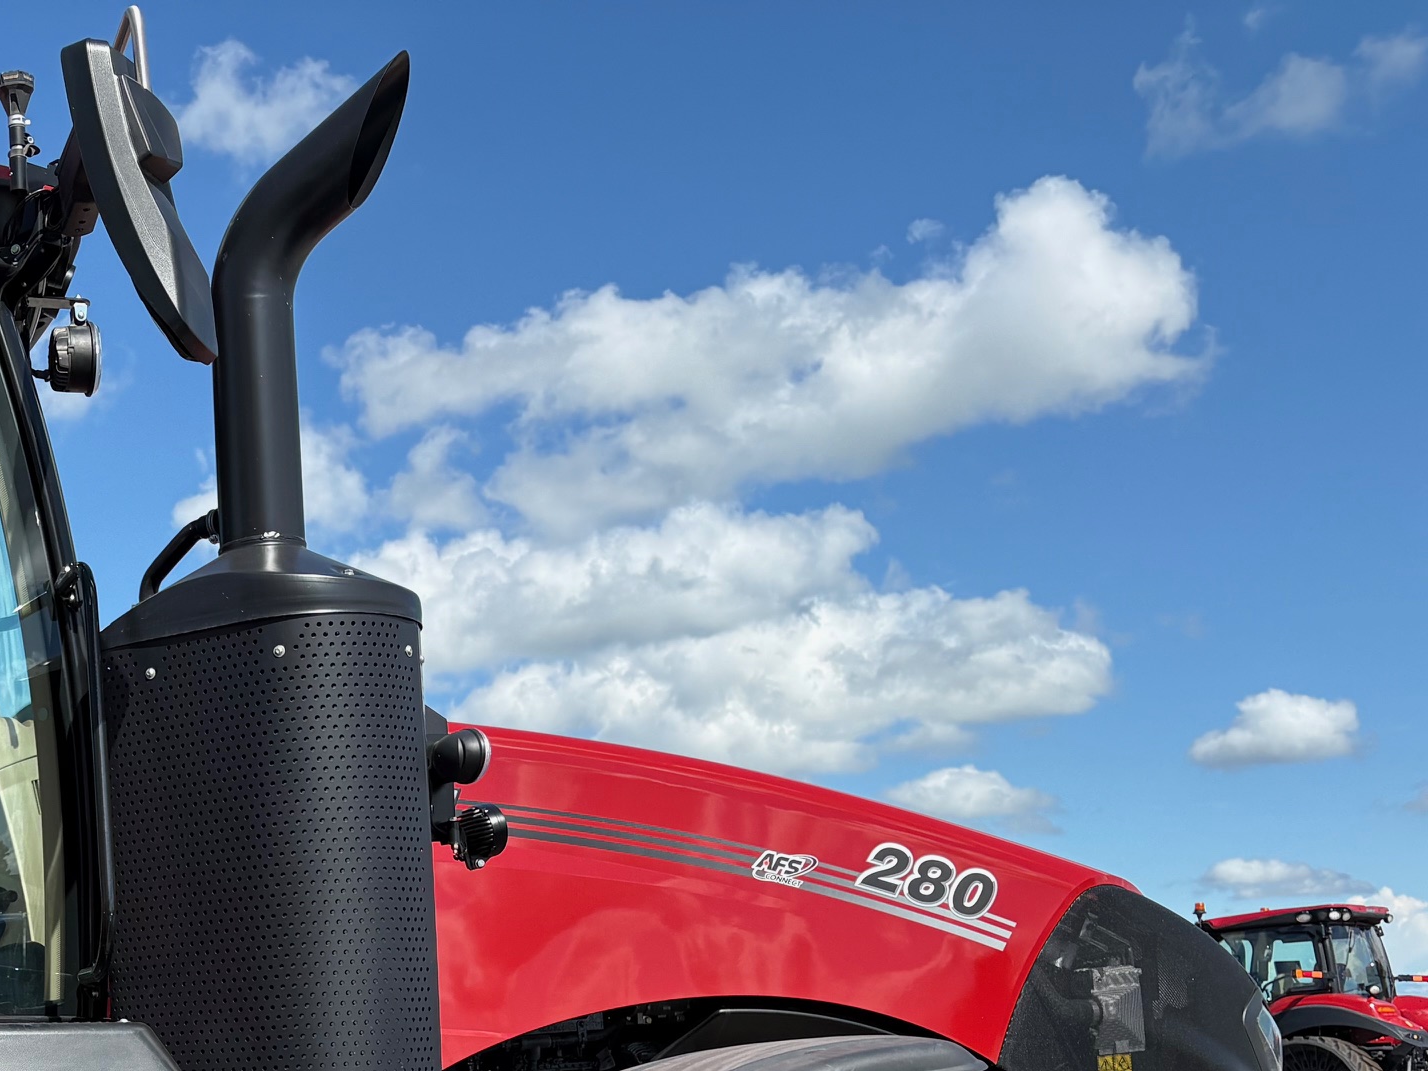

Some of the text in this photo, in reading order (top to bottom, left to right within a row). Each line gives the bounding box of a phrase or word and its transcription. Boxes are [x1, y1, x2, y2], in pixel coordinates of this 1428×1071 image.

[754, 851, 806, 876] AFS
[764, 871, 804, 888] CONNECT
[855, 842, 998, 920] 280
